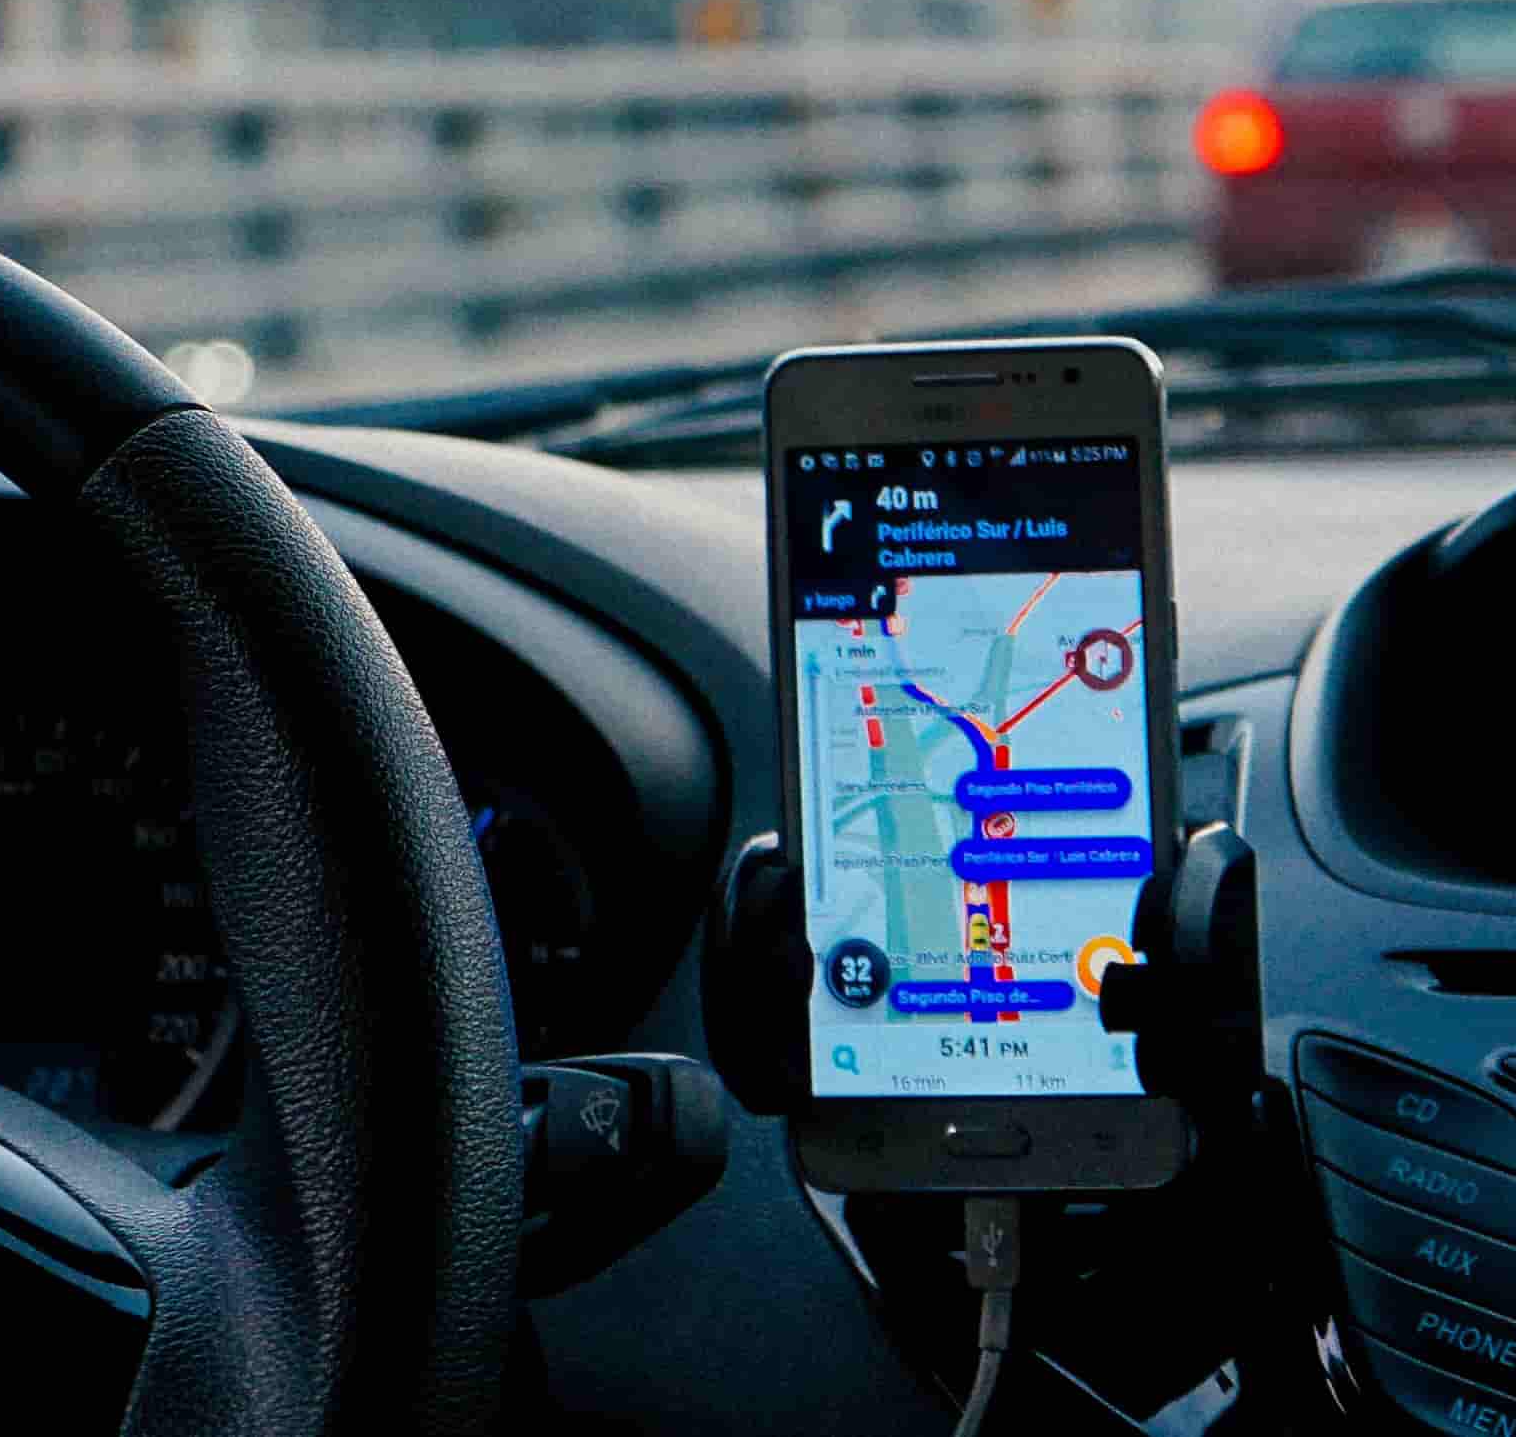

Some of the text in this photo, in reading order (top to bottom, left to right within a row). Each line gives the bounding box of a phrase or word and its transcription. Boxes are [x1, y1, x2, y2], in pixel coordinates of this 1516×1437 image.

[876, 486, 938, 511] 40 m
[877, 520, 973, 542] Periférico
[976, 519, 1011, 540] Sur
[1026, 517, 1069, 538] Luis
[878, 547, 956, 568] Cabrera
[816, 593, 855, 609] luego
[847, 644, 876, 658] min
[840, 955, 873, 982] 32
[898, 989, 967, 1007] Segundo
[970, 988, 1005, 1004] Piso
[940, 1037, 1029, 1058] 5:41 PM
[918, 1074, 946, 1090] min
[1038, 1074, 1066, 1089] km
[1395, 1091, 1440, 1125] CD
[1388, 1155, 1479, 1205] RADIO
[1416, 1237, 1479, 1277] AUX
